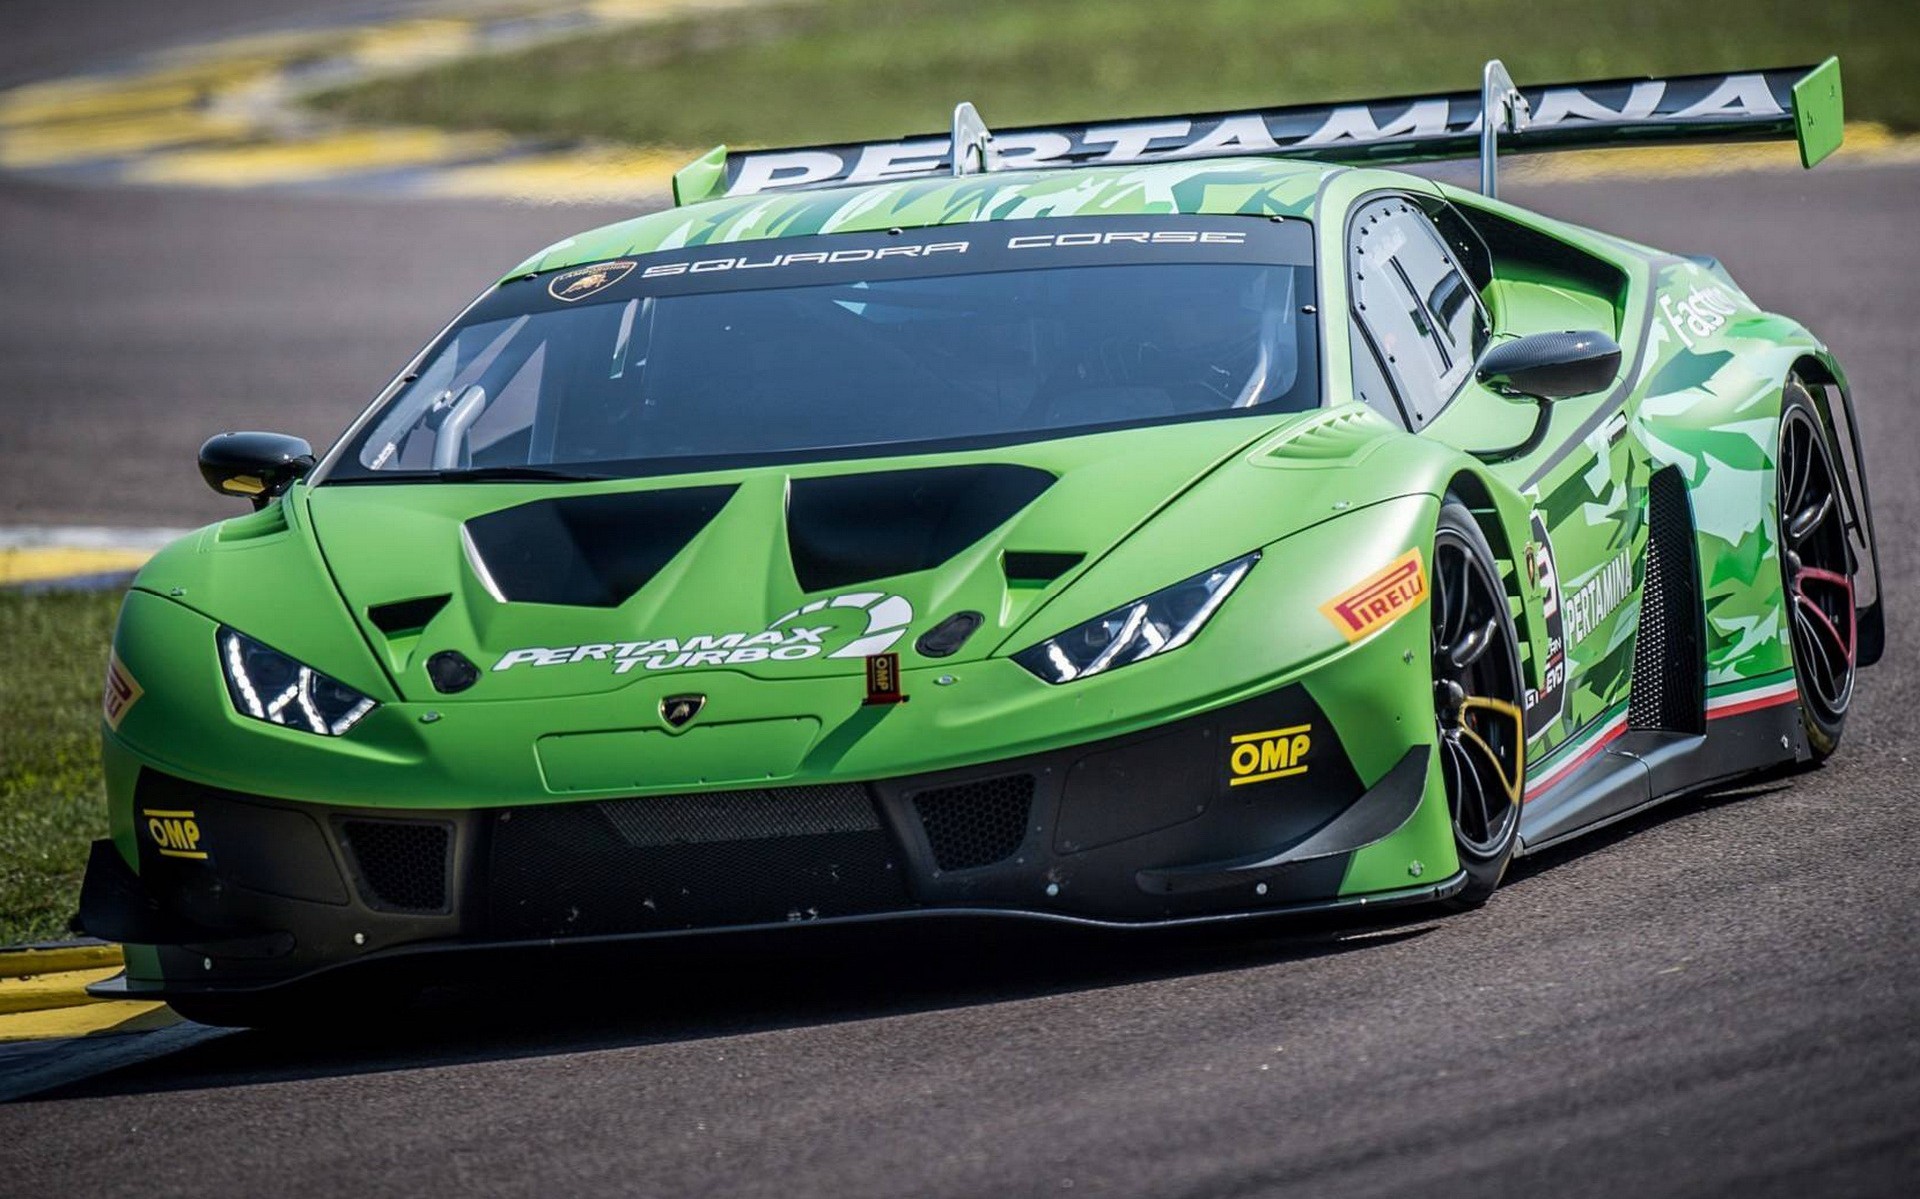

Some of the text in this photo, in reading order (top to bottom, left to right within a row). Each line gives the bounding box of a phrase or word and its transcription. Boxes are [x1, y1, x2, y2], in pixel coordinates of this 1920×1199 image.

[641, 231, 1246, 278] SQUADRA CORSE
[1334, 559, 1423, 632] PIRELLI
[1566, 547, 1632, 650] PERTAMINA
[492, 625, 837, 671] PERTAMAX
[612, 645, 825, 674] TURBO
[875, 657, 889, 690] OMP
[1231, 735, 1310, 774] OMP
[149, 818, 200, 850] OMP
